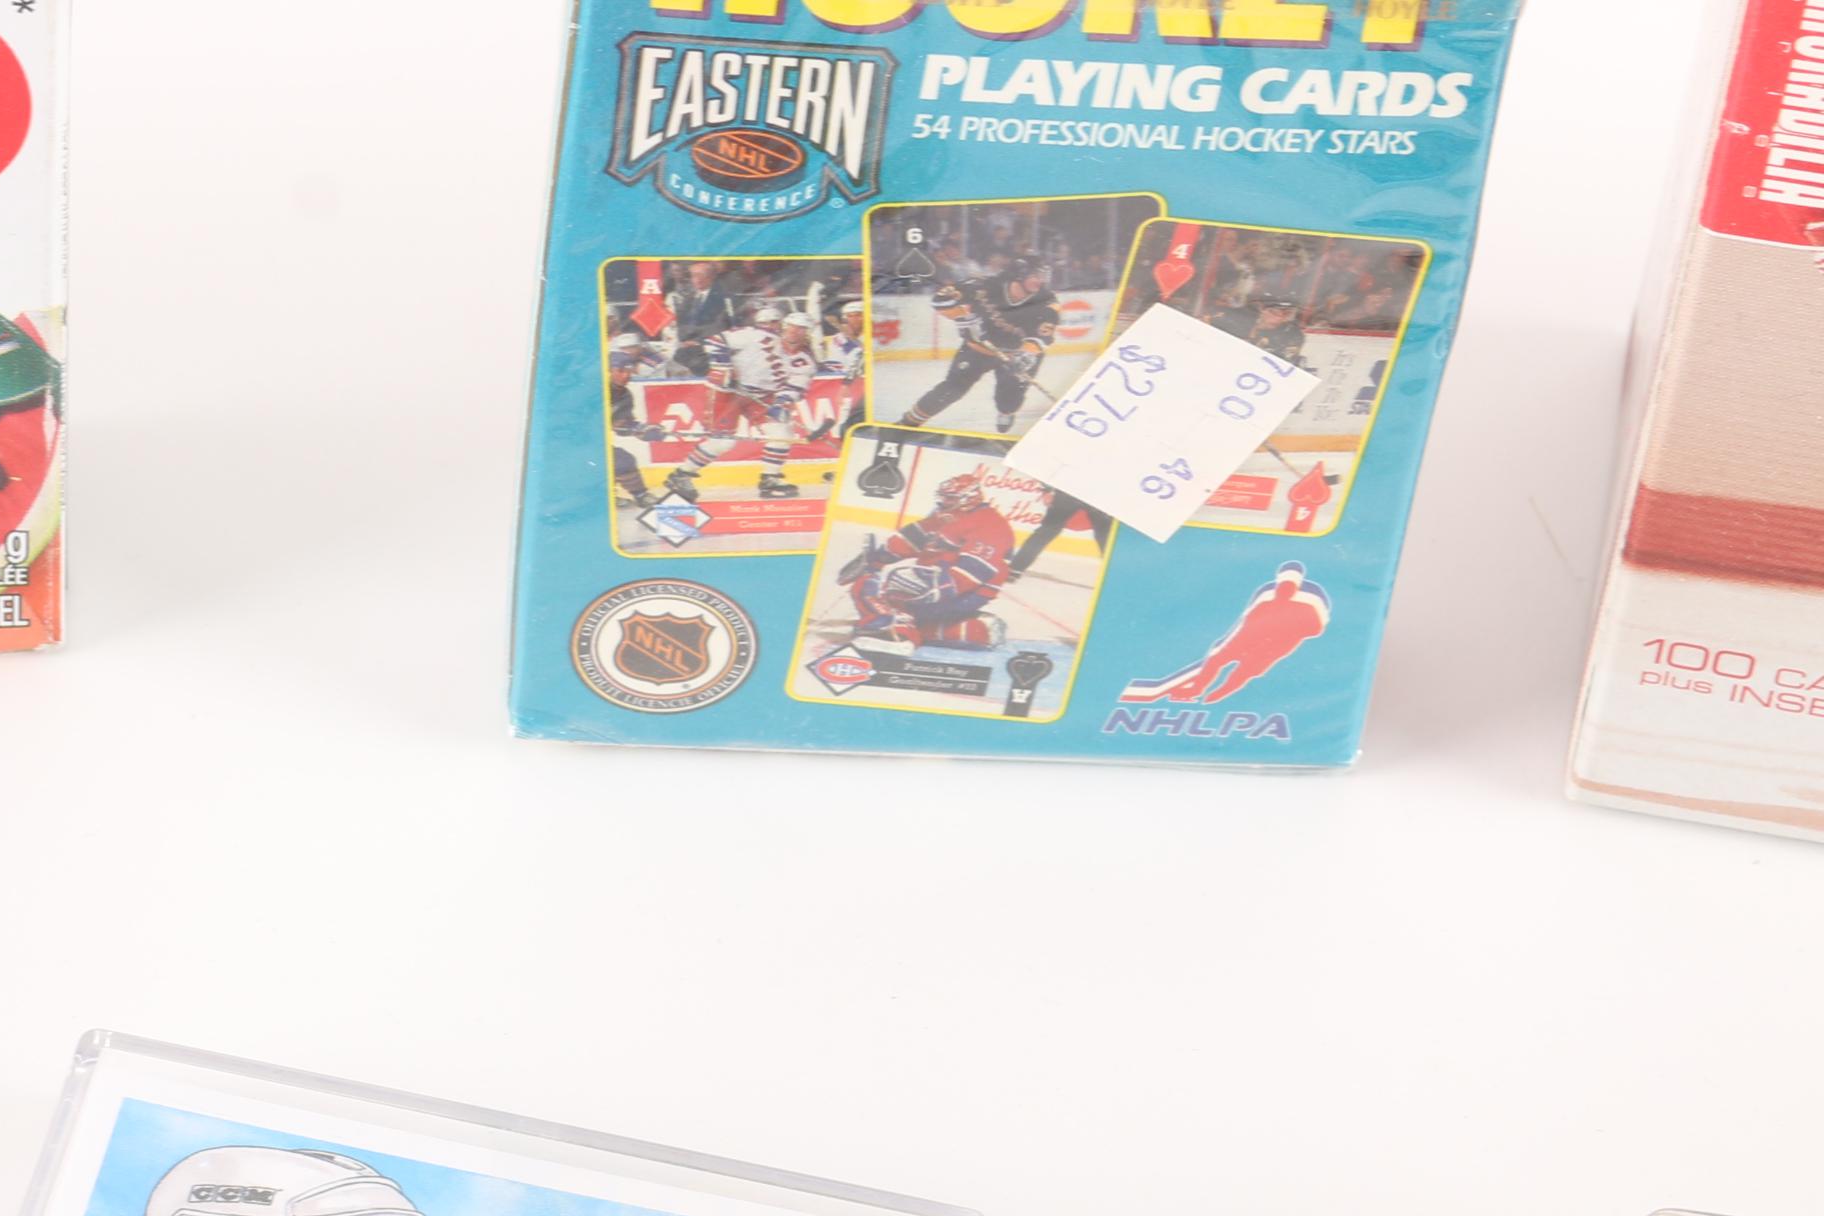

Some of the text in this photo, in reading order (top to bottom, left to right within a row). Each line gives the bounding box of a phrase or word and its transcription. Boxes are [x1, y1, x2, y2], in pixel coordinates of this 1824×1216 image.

[919, 53, 1473, 119] PLAYING CARDS
[630, 46, 878, 180] EASTERN
[911, 112, 1417, 157] 54 PROFESSIONAL HOCKEY STARS
[717, 138, 775, 174] NHL
[669, 172, 818, 213] CONFERENCE
[906, 227, 923, 245] 6
[1170, 243, 1190, 260] 4
[640, 279, 661, 295] A
[1218, 355, 1295, 421] 760
[877, 442, 899, 459] A
[1139, 458, 1194, 502] 46
[6, 528, 30, 562] g
[629, 583, 709, 601] LICENSED
[635, 626, 690, 672] NHL
[1643, 638, 1756, 681] 100
[1639, 670, 1713, 695] plus
[1102, 708, 1292, 740] NHLPA
[189, 1185, 274, 1205] CCM
